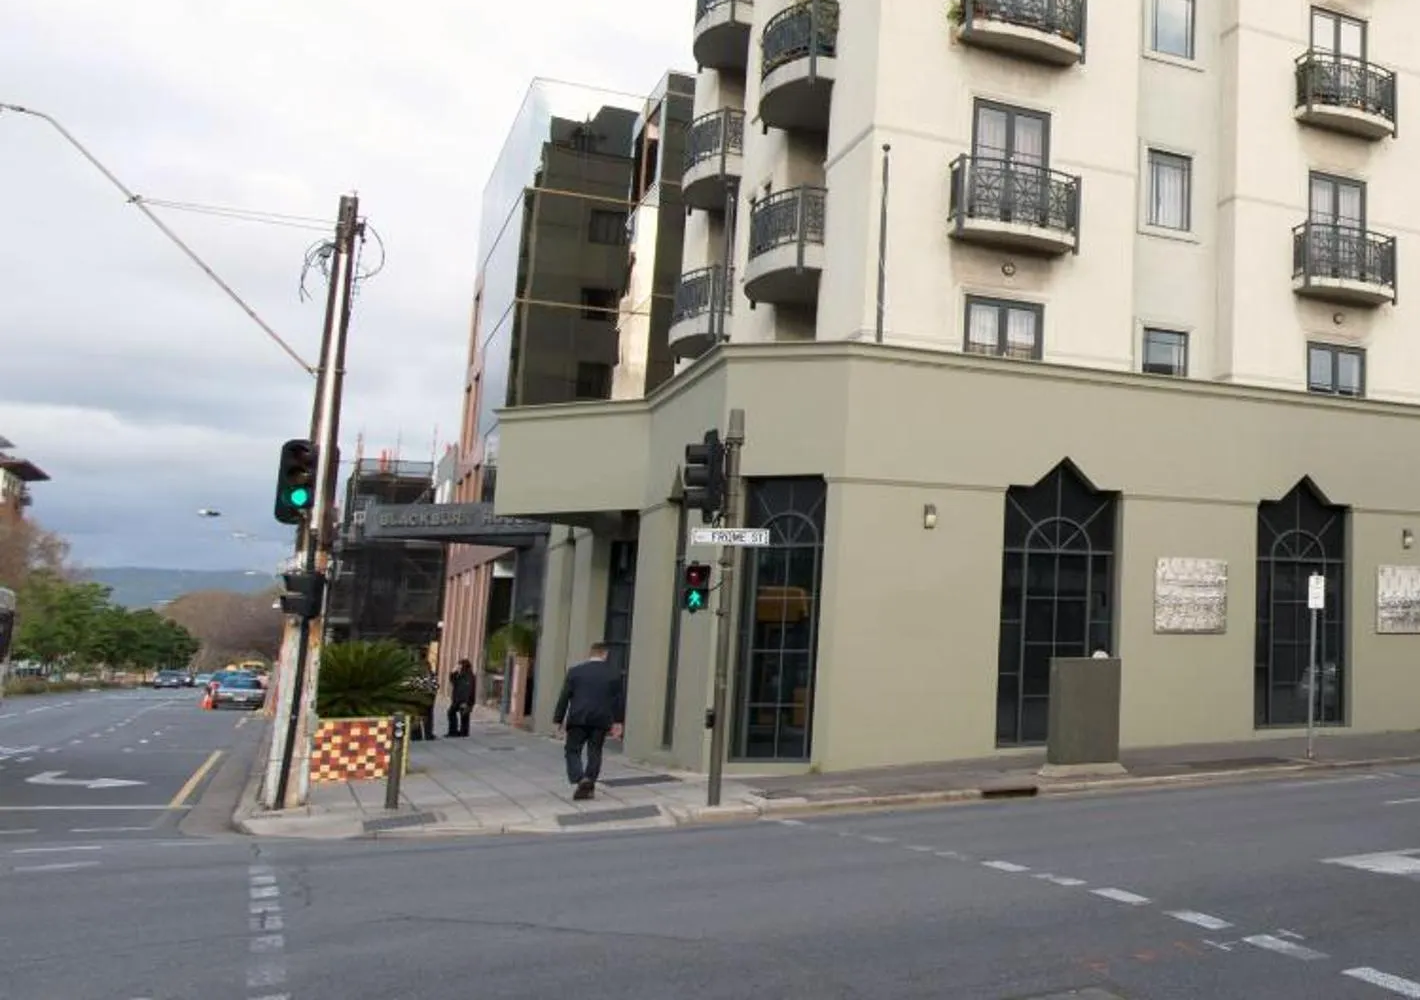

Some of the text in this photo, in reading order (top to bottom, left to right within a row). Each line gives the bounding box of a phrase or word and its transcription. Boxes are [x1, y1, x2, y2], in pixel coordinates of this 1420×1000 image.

[379, 510, 473, 527] BLACKBURN
[711, 531, 764, 543] FROME ST
